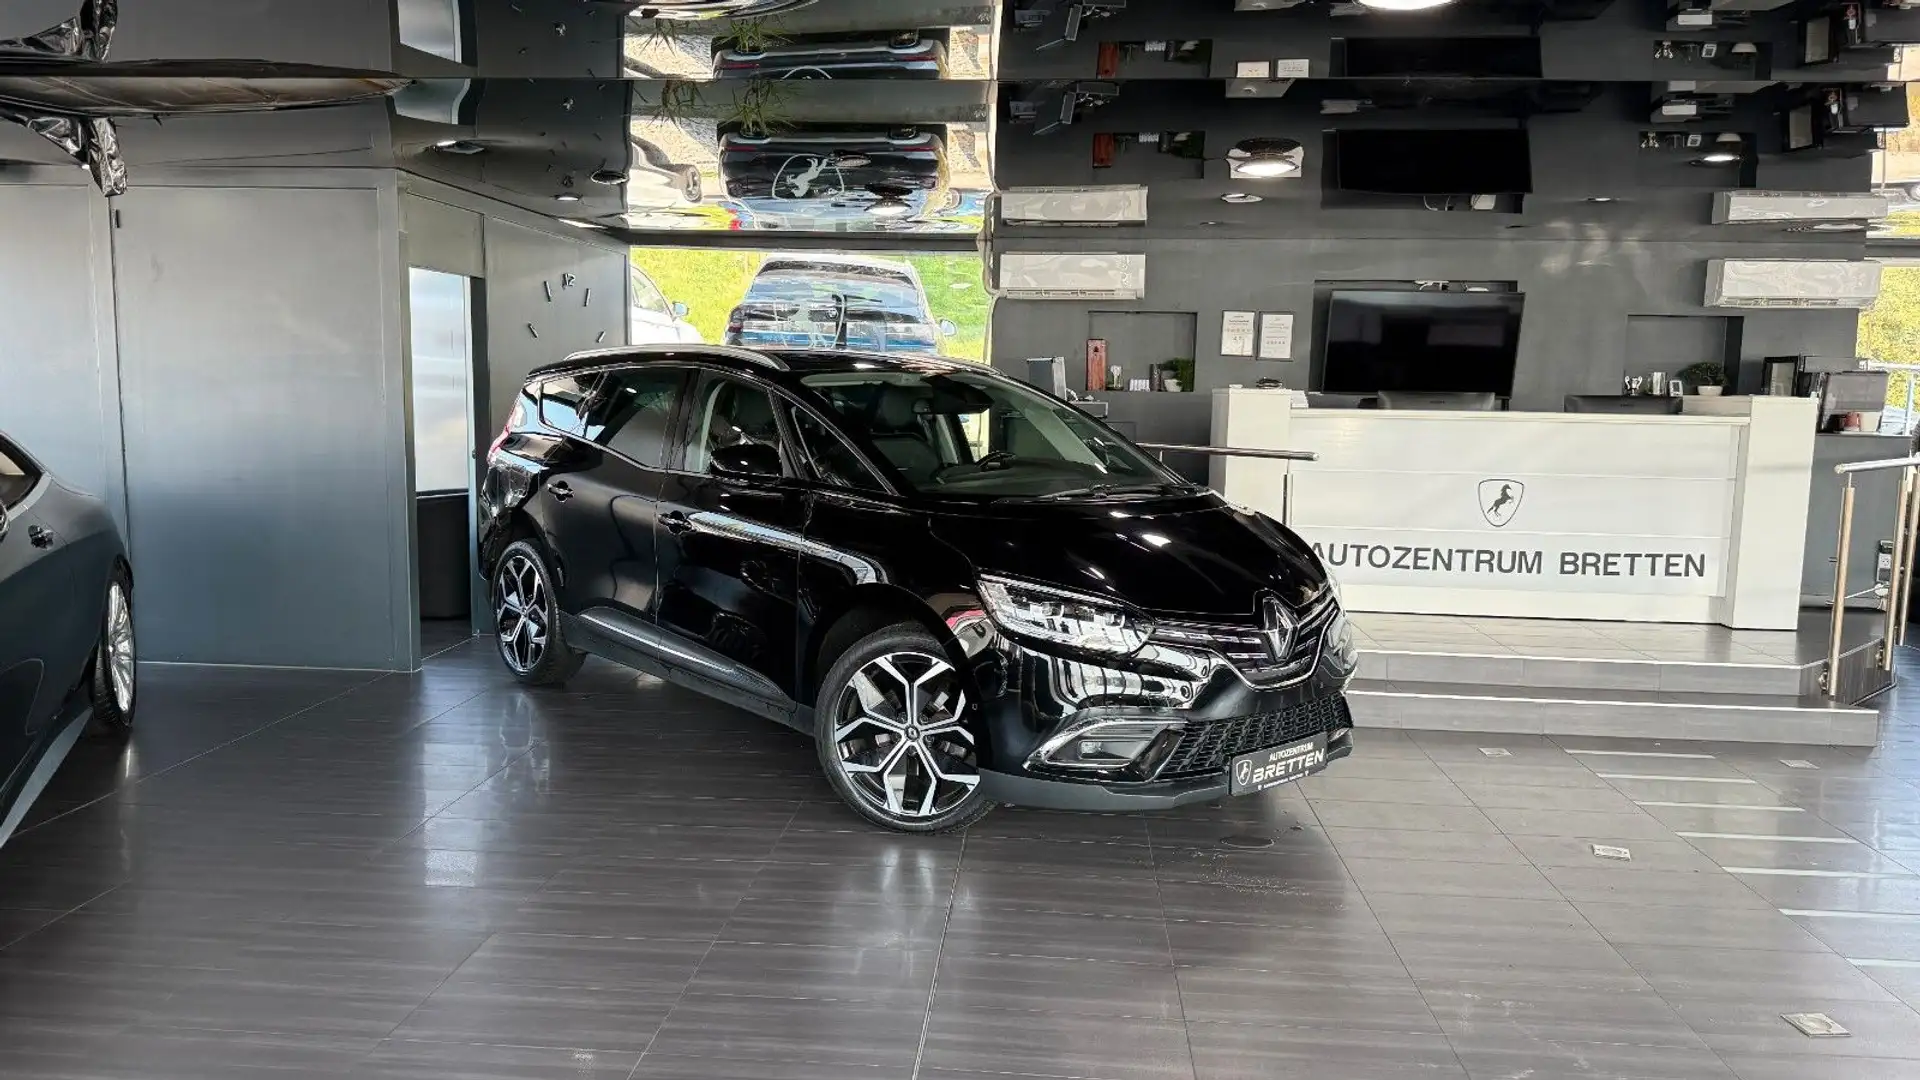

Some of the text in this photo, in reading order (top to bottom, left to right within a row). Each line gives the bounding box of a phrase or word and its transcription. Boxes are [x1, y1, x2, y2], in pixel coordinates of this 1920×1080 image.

[1559, 552, 1706, 577] BRETTEN
[1269, 742, 1314, 762] AUTOZENTRUM
[1252, 748, 1325, 784] BRETTEN
